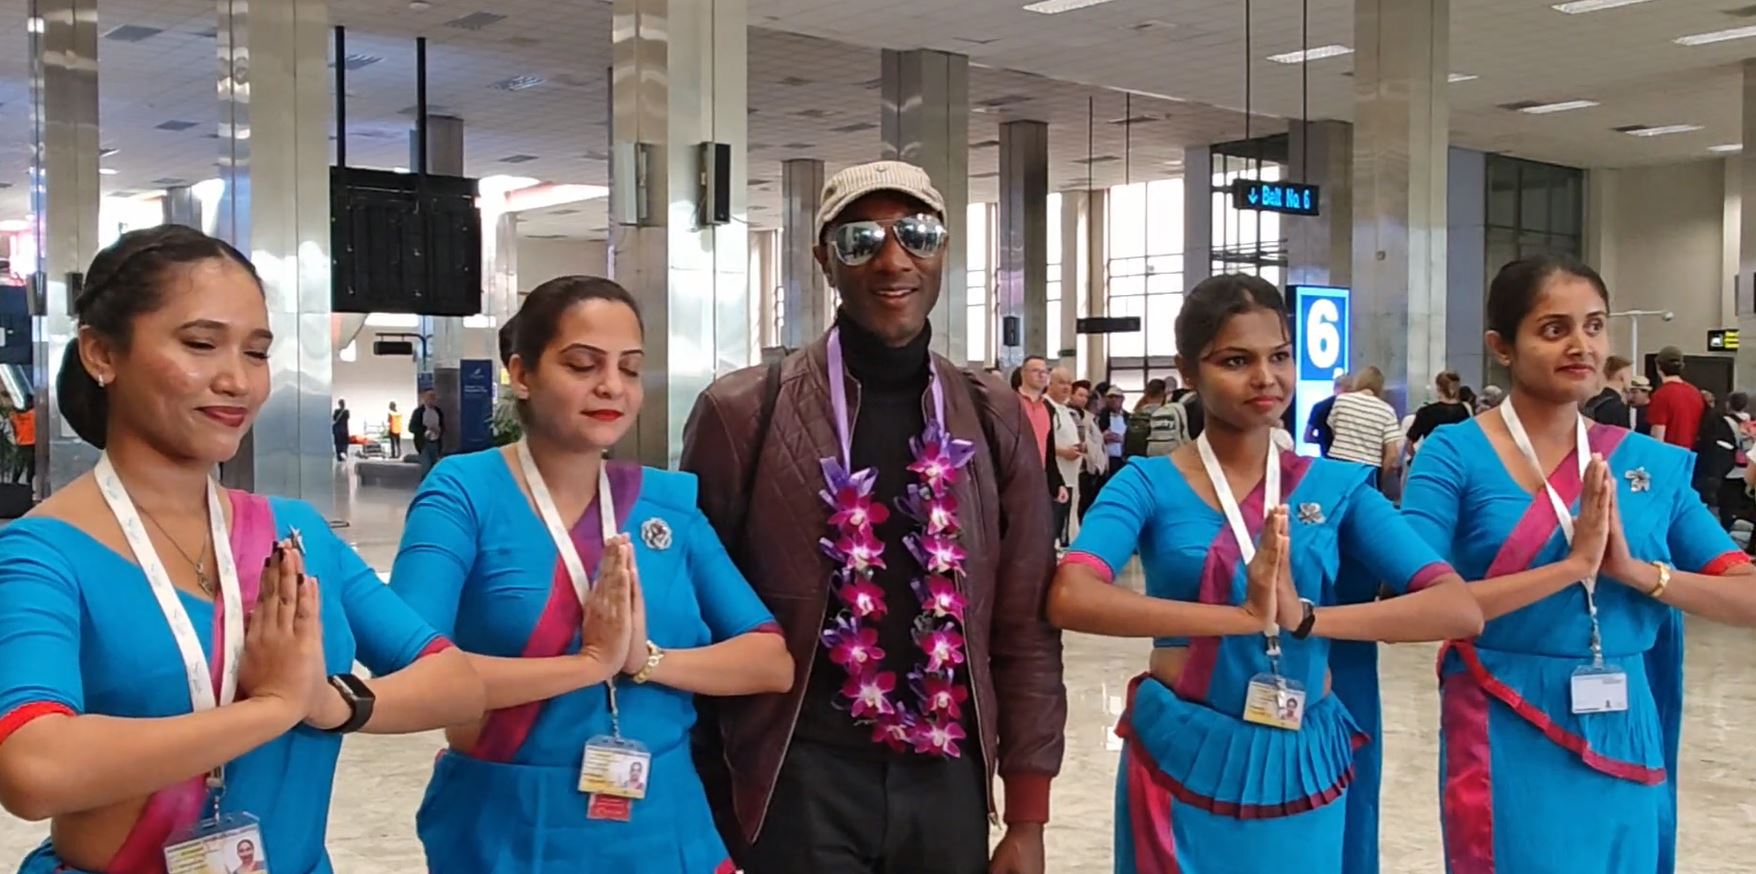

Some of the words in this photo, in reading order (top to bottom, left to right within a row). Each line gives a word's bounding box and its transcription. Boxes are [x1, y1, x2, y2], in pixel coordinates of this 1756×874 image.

[1262, 184, 1282, 206] Belt
[1303, 189, 1310, 209] 6
[1307, 299, 1340, 368] 6
